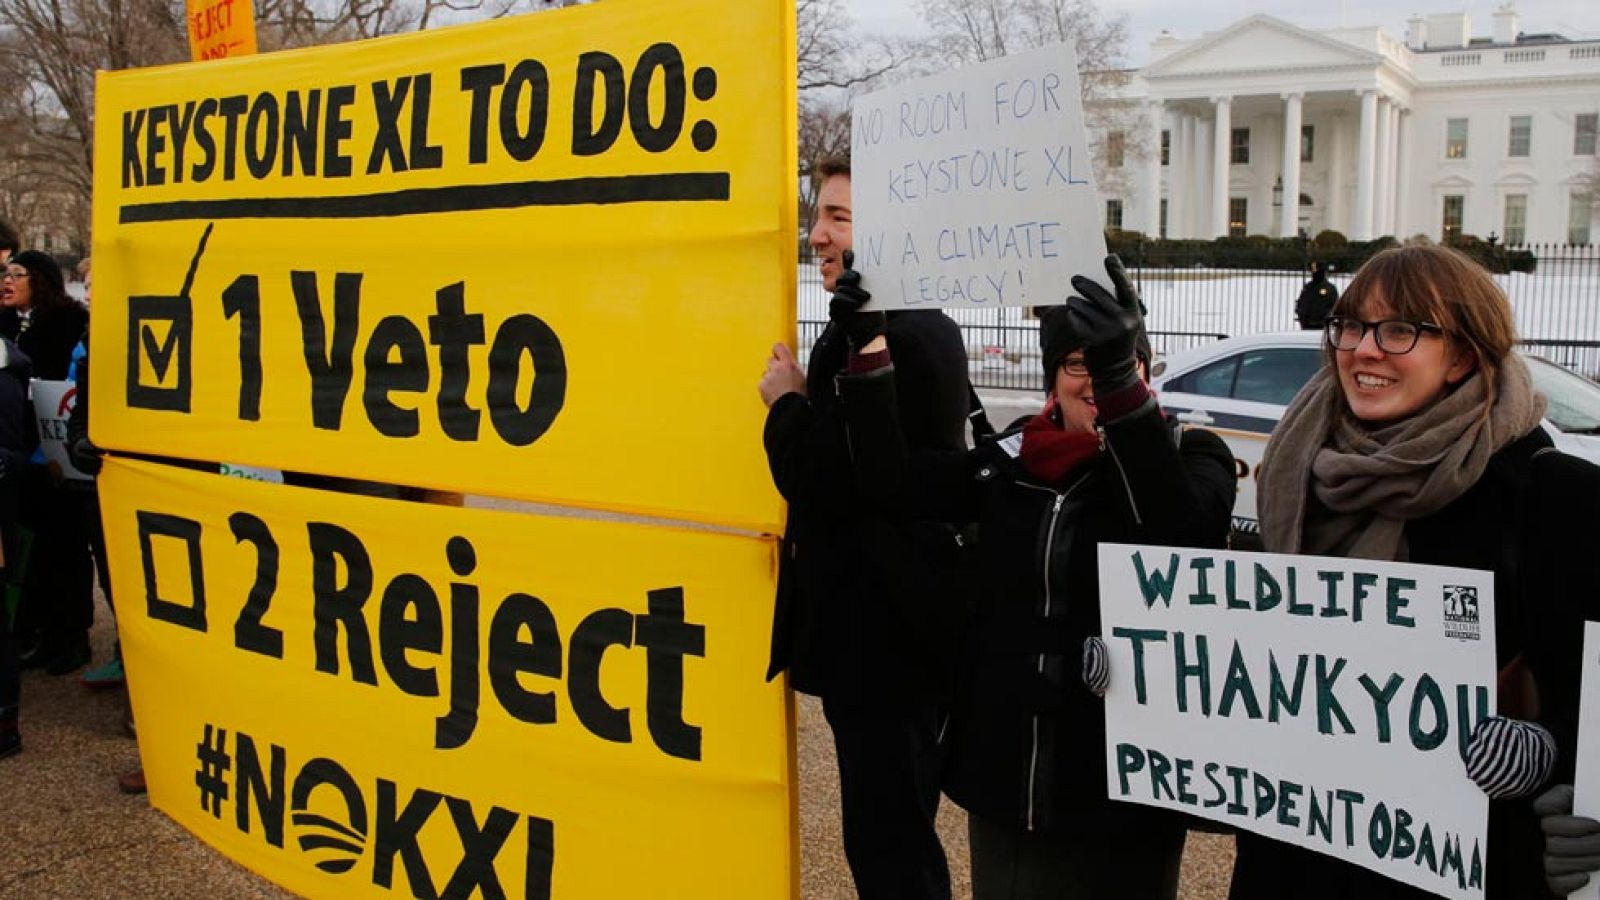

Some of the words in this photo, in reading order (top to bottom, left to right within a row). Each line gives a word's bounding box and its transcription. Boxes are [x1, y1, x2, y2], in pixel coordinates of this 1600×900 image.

[122, 85, 356, 188] KEYSTONE
[366, 73, 442, 177] XL
[460, 59, 549, 164] TO
[572, 42, 718, 156] DO:
[856, 108, 883, 147] NO
[900, 91, 967, 137] ROOM
[995, 73, 1060, 124] FOR
[889, 148, 1028, 203] KEYSTONE
[1045, 146, 1089, 186] XL
[860, 232, 885, 272] IN
[902, 232, 919, 264] A
[938, 222, 1061, 261] CLIMATE
[222, 275, 262, 422] 1
[290, 271, 567, 447] Veto
[1131, 550, 1416, 627] WILDLIFE
[228, 511, 283, 660] 2
[307, 521, 705, 762] Reject
